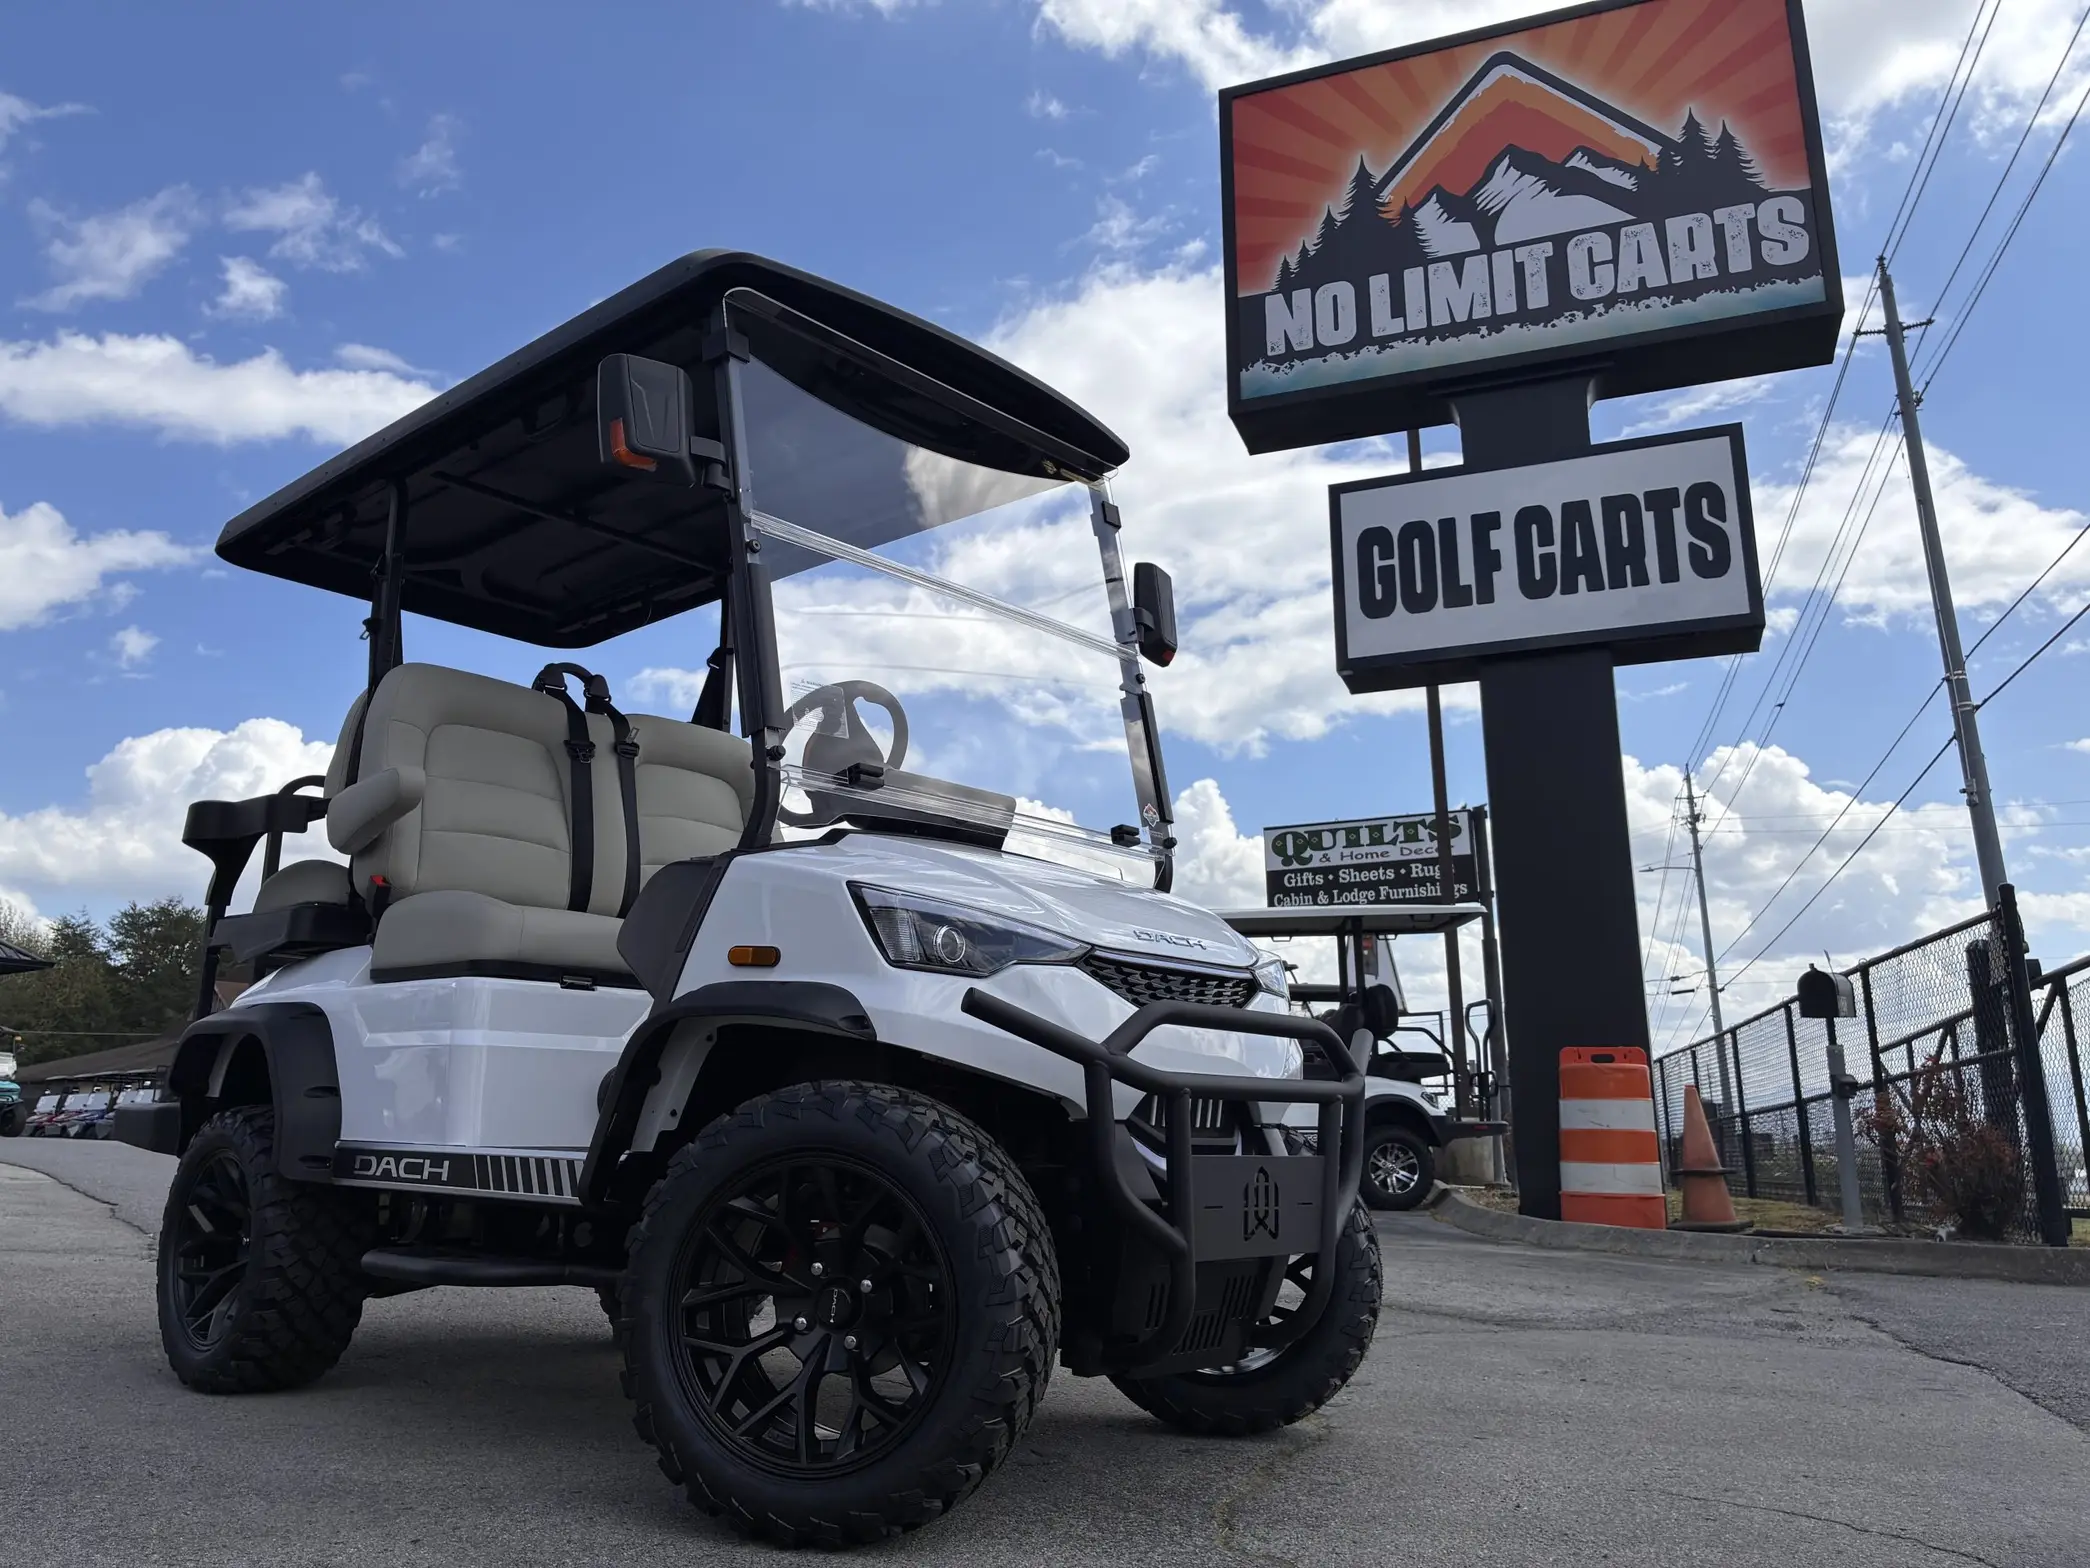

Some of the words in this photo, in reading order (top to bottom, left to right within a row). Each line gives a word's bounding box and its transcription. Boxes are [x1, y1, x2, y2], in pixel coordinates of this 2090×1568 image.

[1265, 280, 1357, 355] NO
[1368, 241, 1554, 339] LIMIT
[1566, 196, 1810, 301] CARTS
[1356, 511, 1502, 619] GOLF
[1514, 481, 1732, 600] CARTS
[1271, 814, 1462, 867] QUILTS
[1319, 852, 1331, 862] &
[1340, 850, 1391, 861] Home
[1400, 844, 1455, 857] Dec
[1283, 871, 1324, 887] Gifts
[1338, 866, 1395, 883] Sheets
[1273, 892, 1314, 907] Cabin
[1317, 890, 1330, 905] &
[1332, 888, 1376, 904] Lodge
[1378, 880, 1468, 900] Furnishigs
[353, 1154, 450, 1181] DACH
